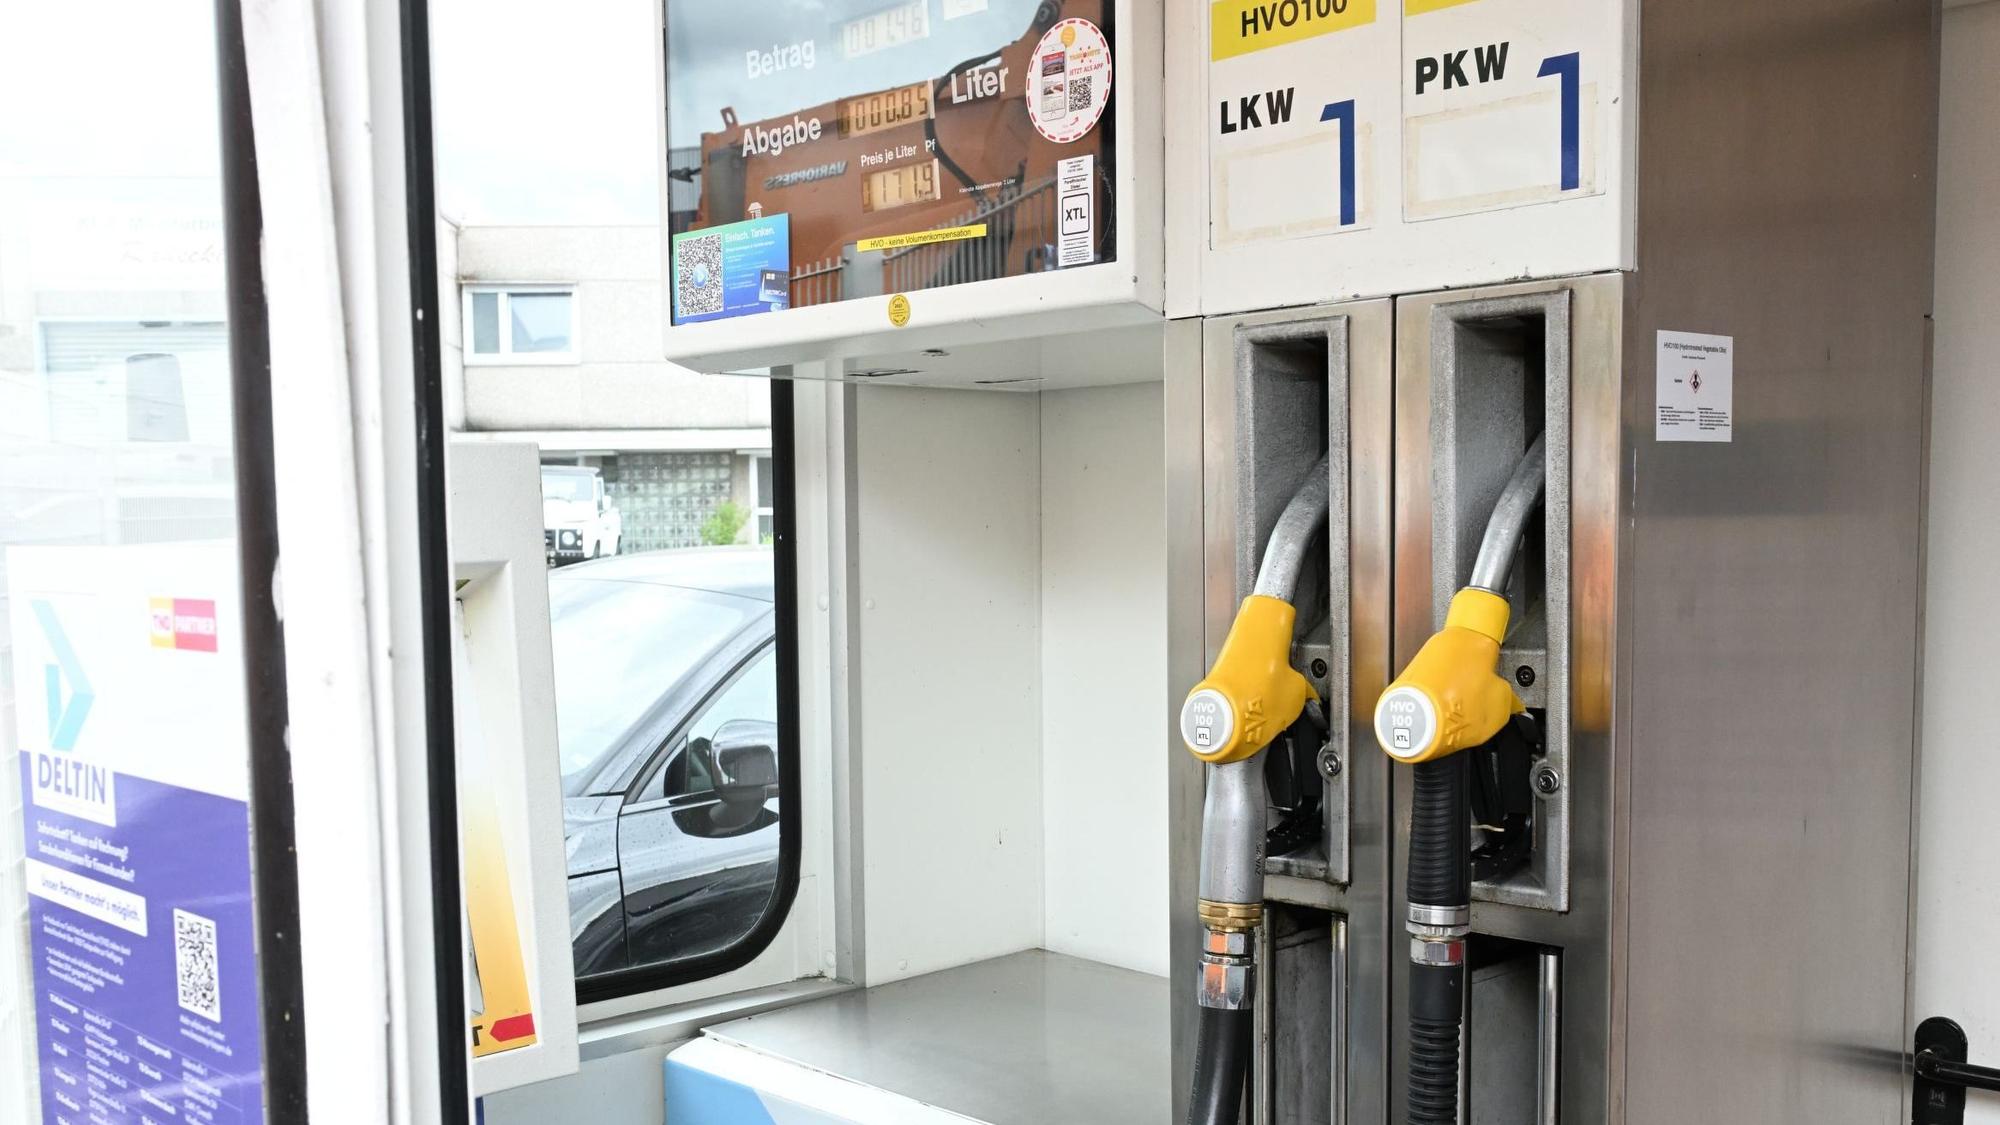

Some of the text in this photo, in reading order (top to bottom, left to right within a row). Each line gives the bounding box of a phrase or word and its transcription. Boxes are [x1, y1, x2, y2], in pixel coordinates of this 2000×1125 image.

[1242, 0, 1347, 37] HVO100
[745, 39, 816, 79] Betrag
[1415, 42, 1509, 95] PKW
[951, 65, 1009, 105] Liter
[1220, 87, 1294, 134] LKW
[1536, 51, 1580, 191] 1
[742, 115, 822, 157] Abgabe
[861, 138, 936, 168] Preis je Liter Pf
[1319, 99, 1356, 226] 1
[1065, 207, 1086, 222] XTL
[870, 239, 883, 249] HVO
[889, 236, 904, 246] keine
[905, 228, 971, 245] Volumenkompensation
[1193, 702, 1216, 714] HVO
[1195, 715, 1213, 726] 100
[1390, 700, 1416, 713] HVO
[1392, 714, 1413, 727] 100
[1396, 734, 1408, 742] XTL
[38, 753, 106, 805] DELTIN
